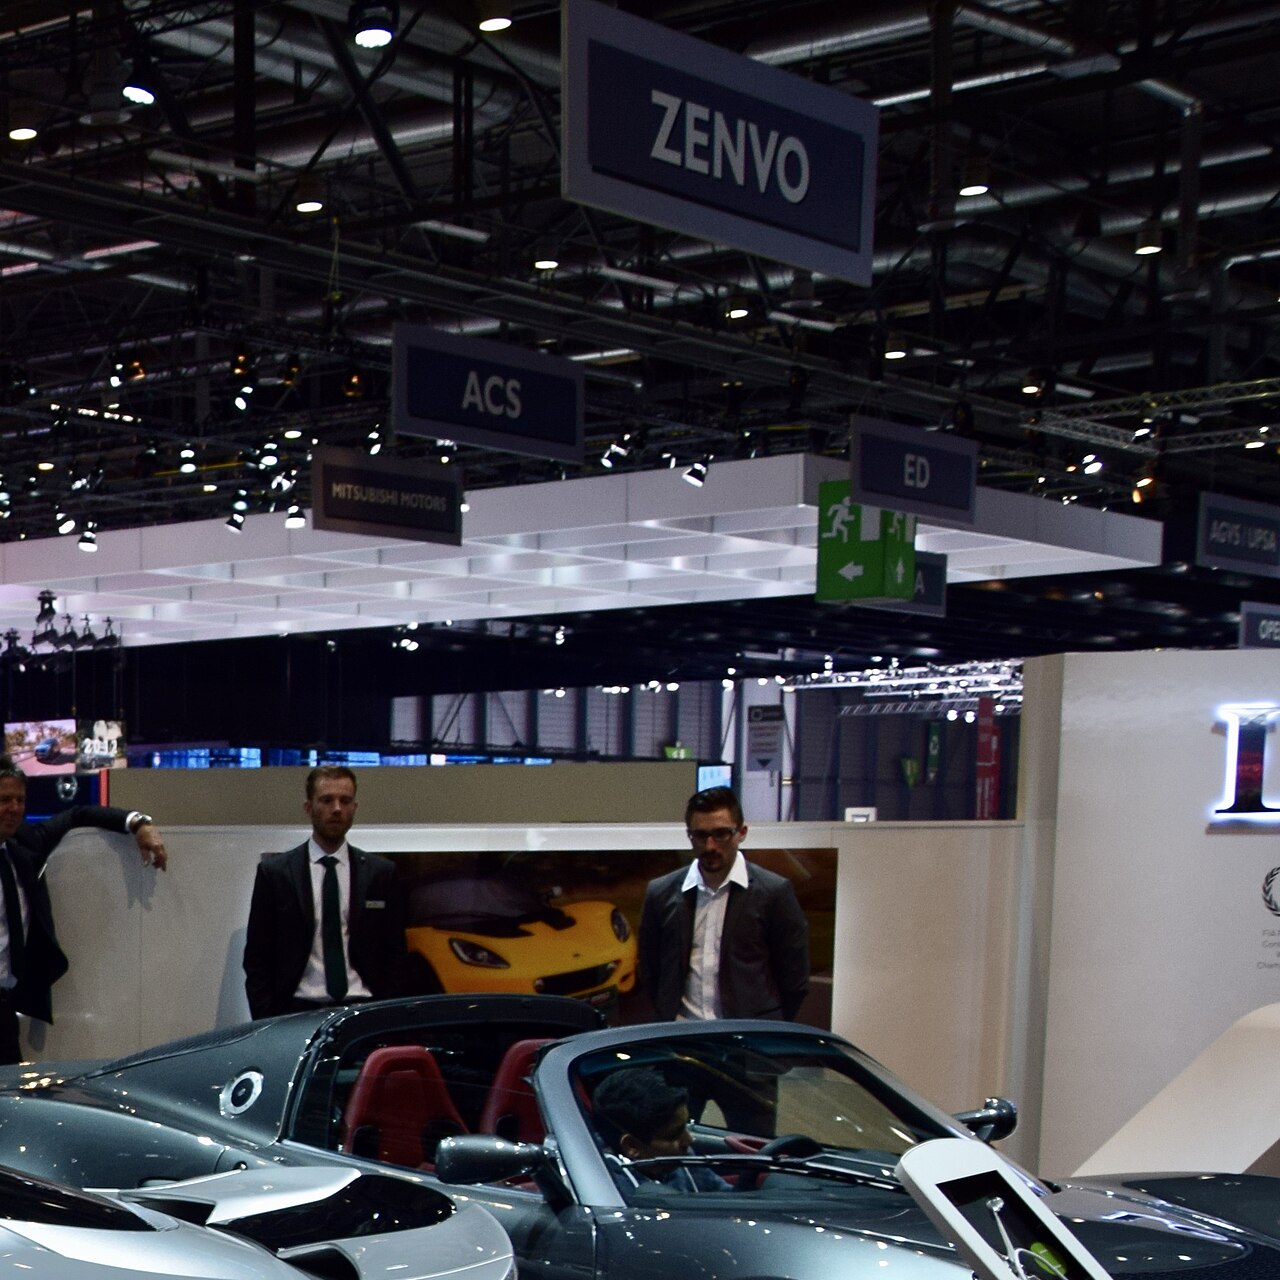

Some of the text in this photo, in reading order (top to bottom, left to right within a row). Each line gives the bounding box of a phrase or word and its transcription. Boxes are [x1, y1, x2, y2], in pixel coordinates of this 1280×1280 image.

[650, 88, 811, 205] ZENVO
[461, 369, 523, 420] ACS
[903, 452, 931, 489] ED
[331, 481, 448, 512] MITSUBISHI MOTORS
